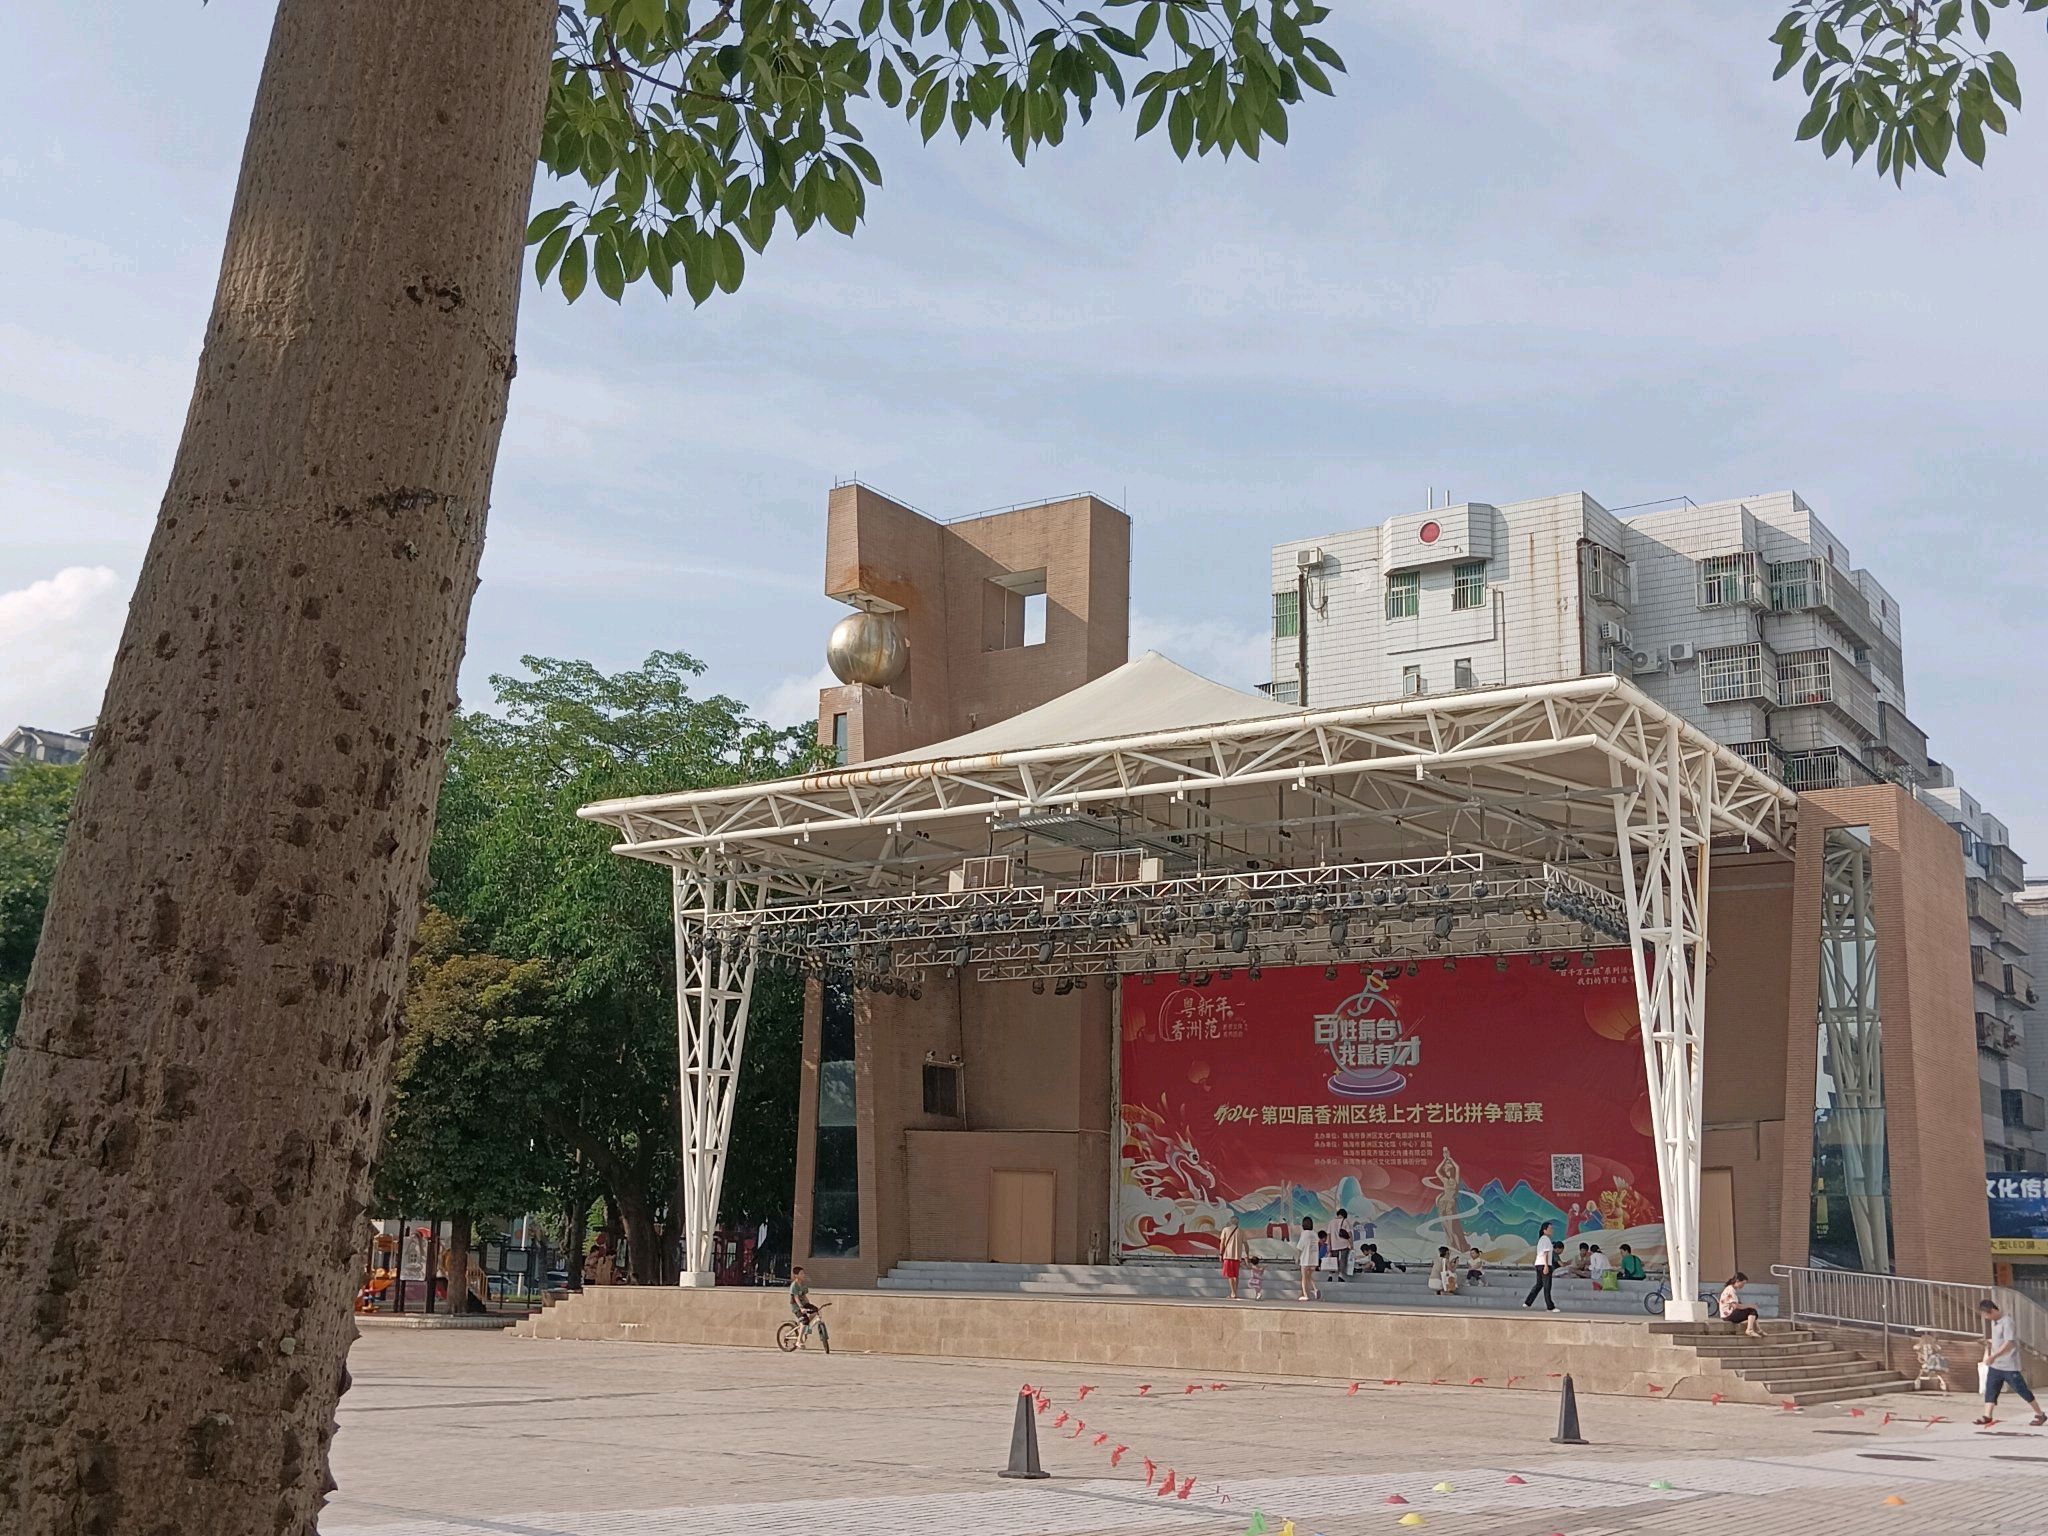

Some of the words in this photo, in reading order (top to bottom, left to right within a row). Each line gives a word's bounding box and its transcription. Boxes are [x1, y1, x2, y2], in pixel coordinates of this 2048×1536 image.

[1577, 976, 1634, 986] 我们的节日·春
[1181, 997, 1231, 1020] 粤新年
[1172, 1018, 1220, 1040] 香洲范
[1313, 1014, 1397, 1044] 百姓舞台
[1339, 1036, 1421, 1066] 我最有才
[1986, 1178, 2048, 1198] 文化传
